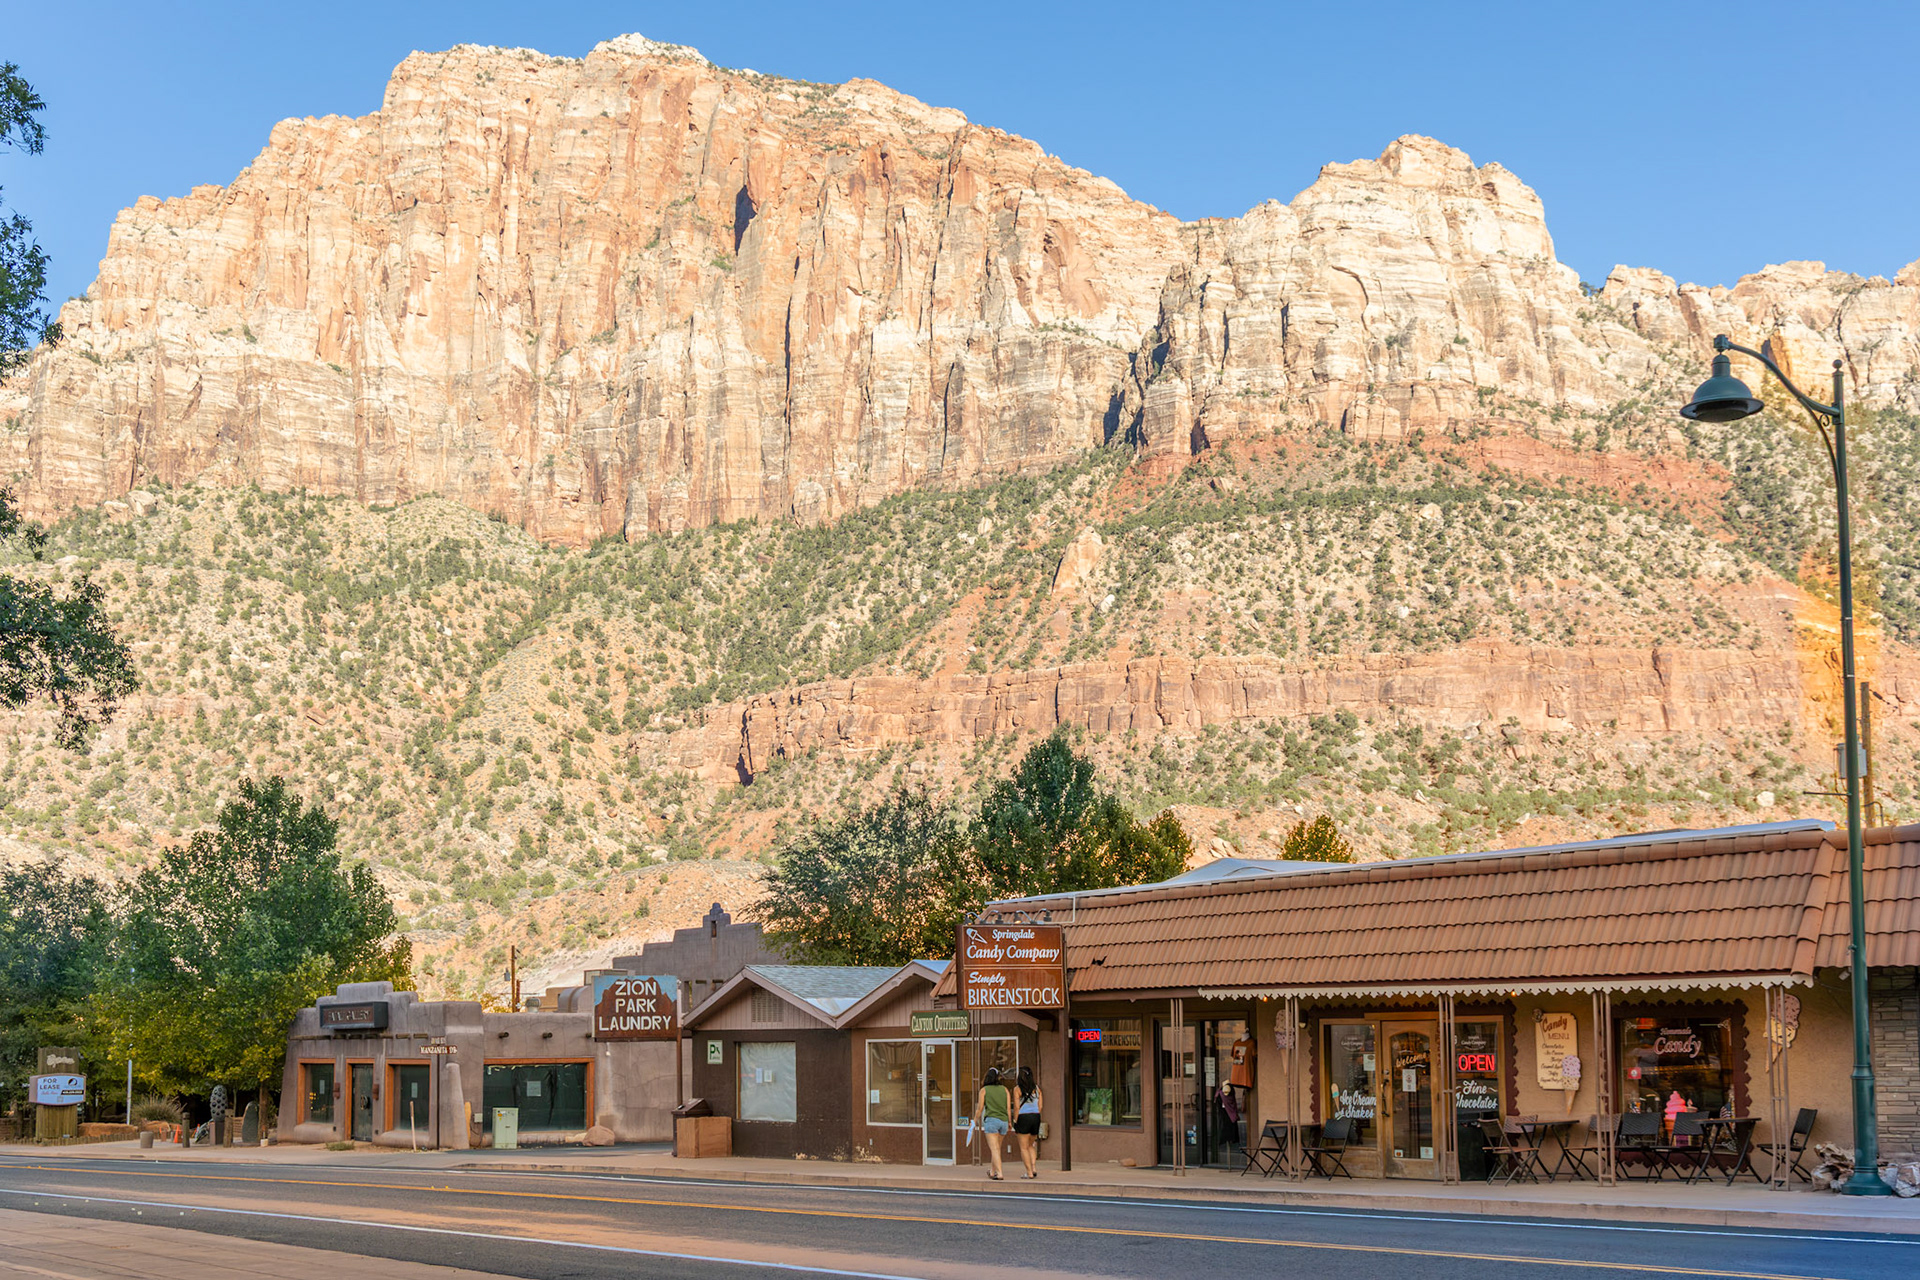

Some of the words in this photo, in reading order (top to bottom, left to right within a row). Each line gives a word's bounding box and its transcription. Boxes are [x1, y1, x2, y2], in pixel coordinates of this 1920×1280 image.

[992, 929, 1035, 941] Springdale
[966, 945, 1005, 962] Candy
[1006, 945, 1060, 962] Company
[968, 972, 1006, 986] Simply
[615, 981, 657, 996] ZION
[968, 988, 1060, 1006] BIRKENSTOCK
[615, 998, 657, 1013] PARK
[599, 1015, 672, 1031] LAUNDRY
[1542, 1016, 1568, 1032] Candy
[1078, 1031, 1100, 1041] OPEN
[420, 1046, 448, 1054] MANZANITA
[1654, 1034, 1702, 1058] Candy
[1458, 1054, 1496, 1071] OPEN
[1462, 1080, 1487, 1095] Fine
[1340, 1090, 1353, 1105] Ice
[1353, 1090, 1377, 1106] Cream
[1345, 1105, 1374, 1119] Shakes
